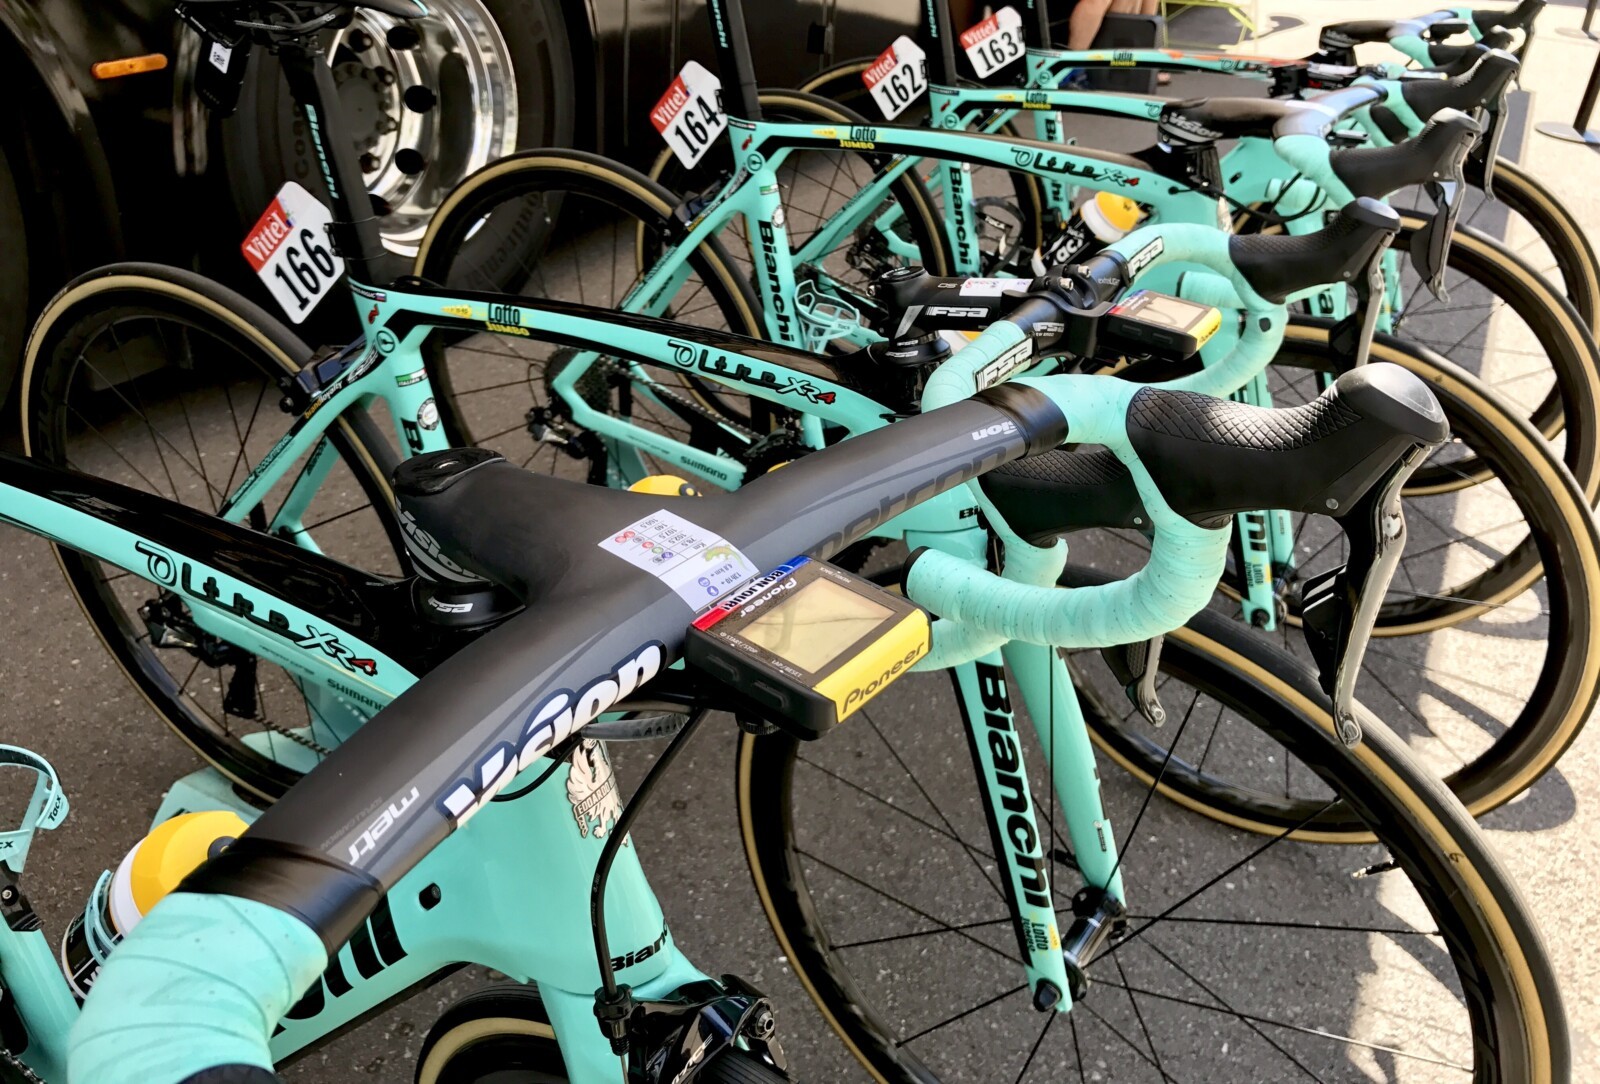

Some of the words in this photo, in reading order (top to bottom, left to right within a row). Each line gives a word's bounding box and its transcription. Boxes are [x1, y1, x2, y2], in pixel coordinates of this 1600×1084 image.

[963, 19, 997, 45] Vittel
[977, 31, 1018, 72] 163
[865, 52, 896, 84] Vittel
[881, 63, 923, 113] 162
[653, 86, 688, 126] Vittel
[674, 94, 721, 159] 164
[850, 126, 877, 141] Lotto
[305, 103, 340, 199] Bianchi
[948, 166, 973, 266] Bianchi
[245, 211, 289, 262] Vittel
[274, 228, 336, 311] 166
[1128, 236, 1164, 278] FSA
[758, 220, 794, 342] Bianchi
[485, 321, 530, 336] JUMBO
[488, 303, 521, 326] Lotto
[926, 306, 989, 318] FSA
[976, 337, 1034, 392] FSA
[776, 377, 836, 404] XR4
[680, 456, 728, 480] SHIMANO
[427, 596, 473, 613] FSA
[723, 570, 785, 611] BONJOUR!
[740, 578, 797, 618] Pioneer
[294, 625, 378, 676] XR4
[726, 634, 759, 654] START/STOP
[842, 642, 925, 714] Pioneer
[578, 785, 610, 816] EDOARDO
[975, 660, 1051, 908] Bianchi
[48, 795, 62, 822] Tacx
